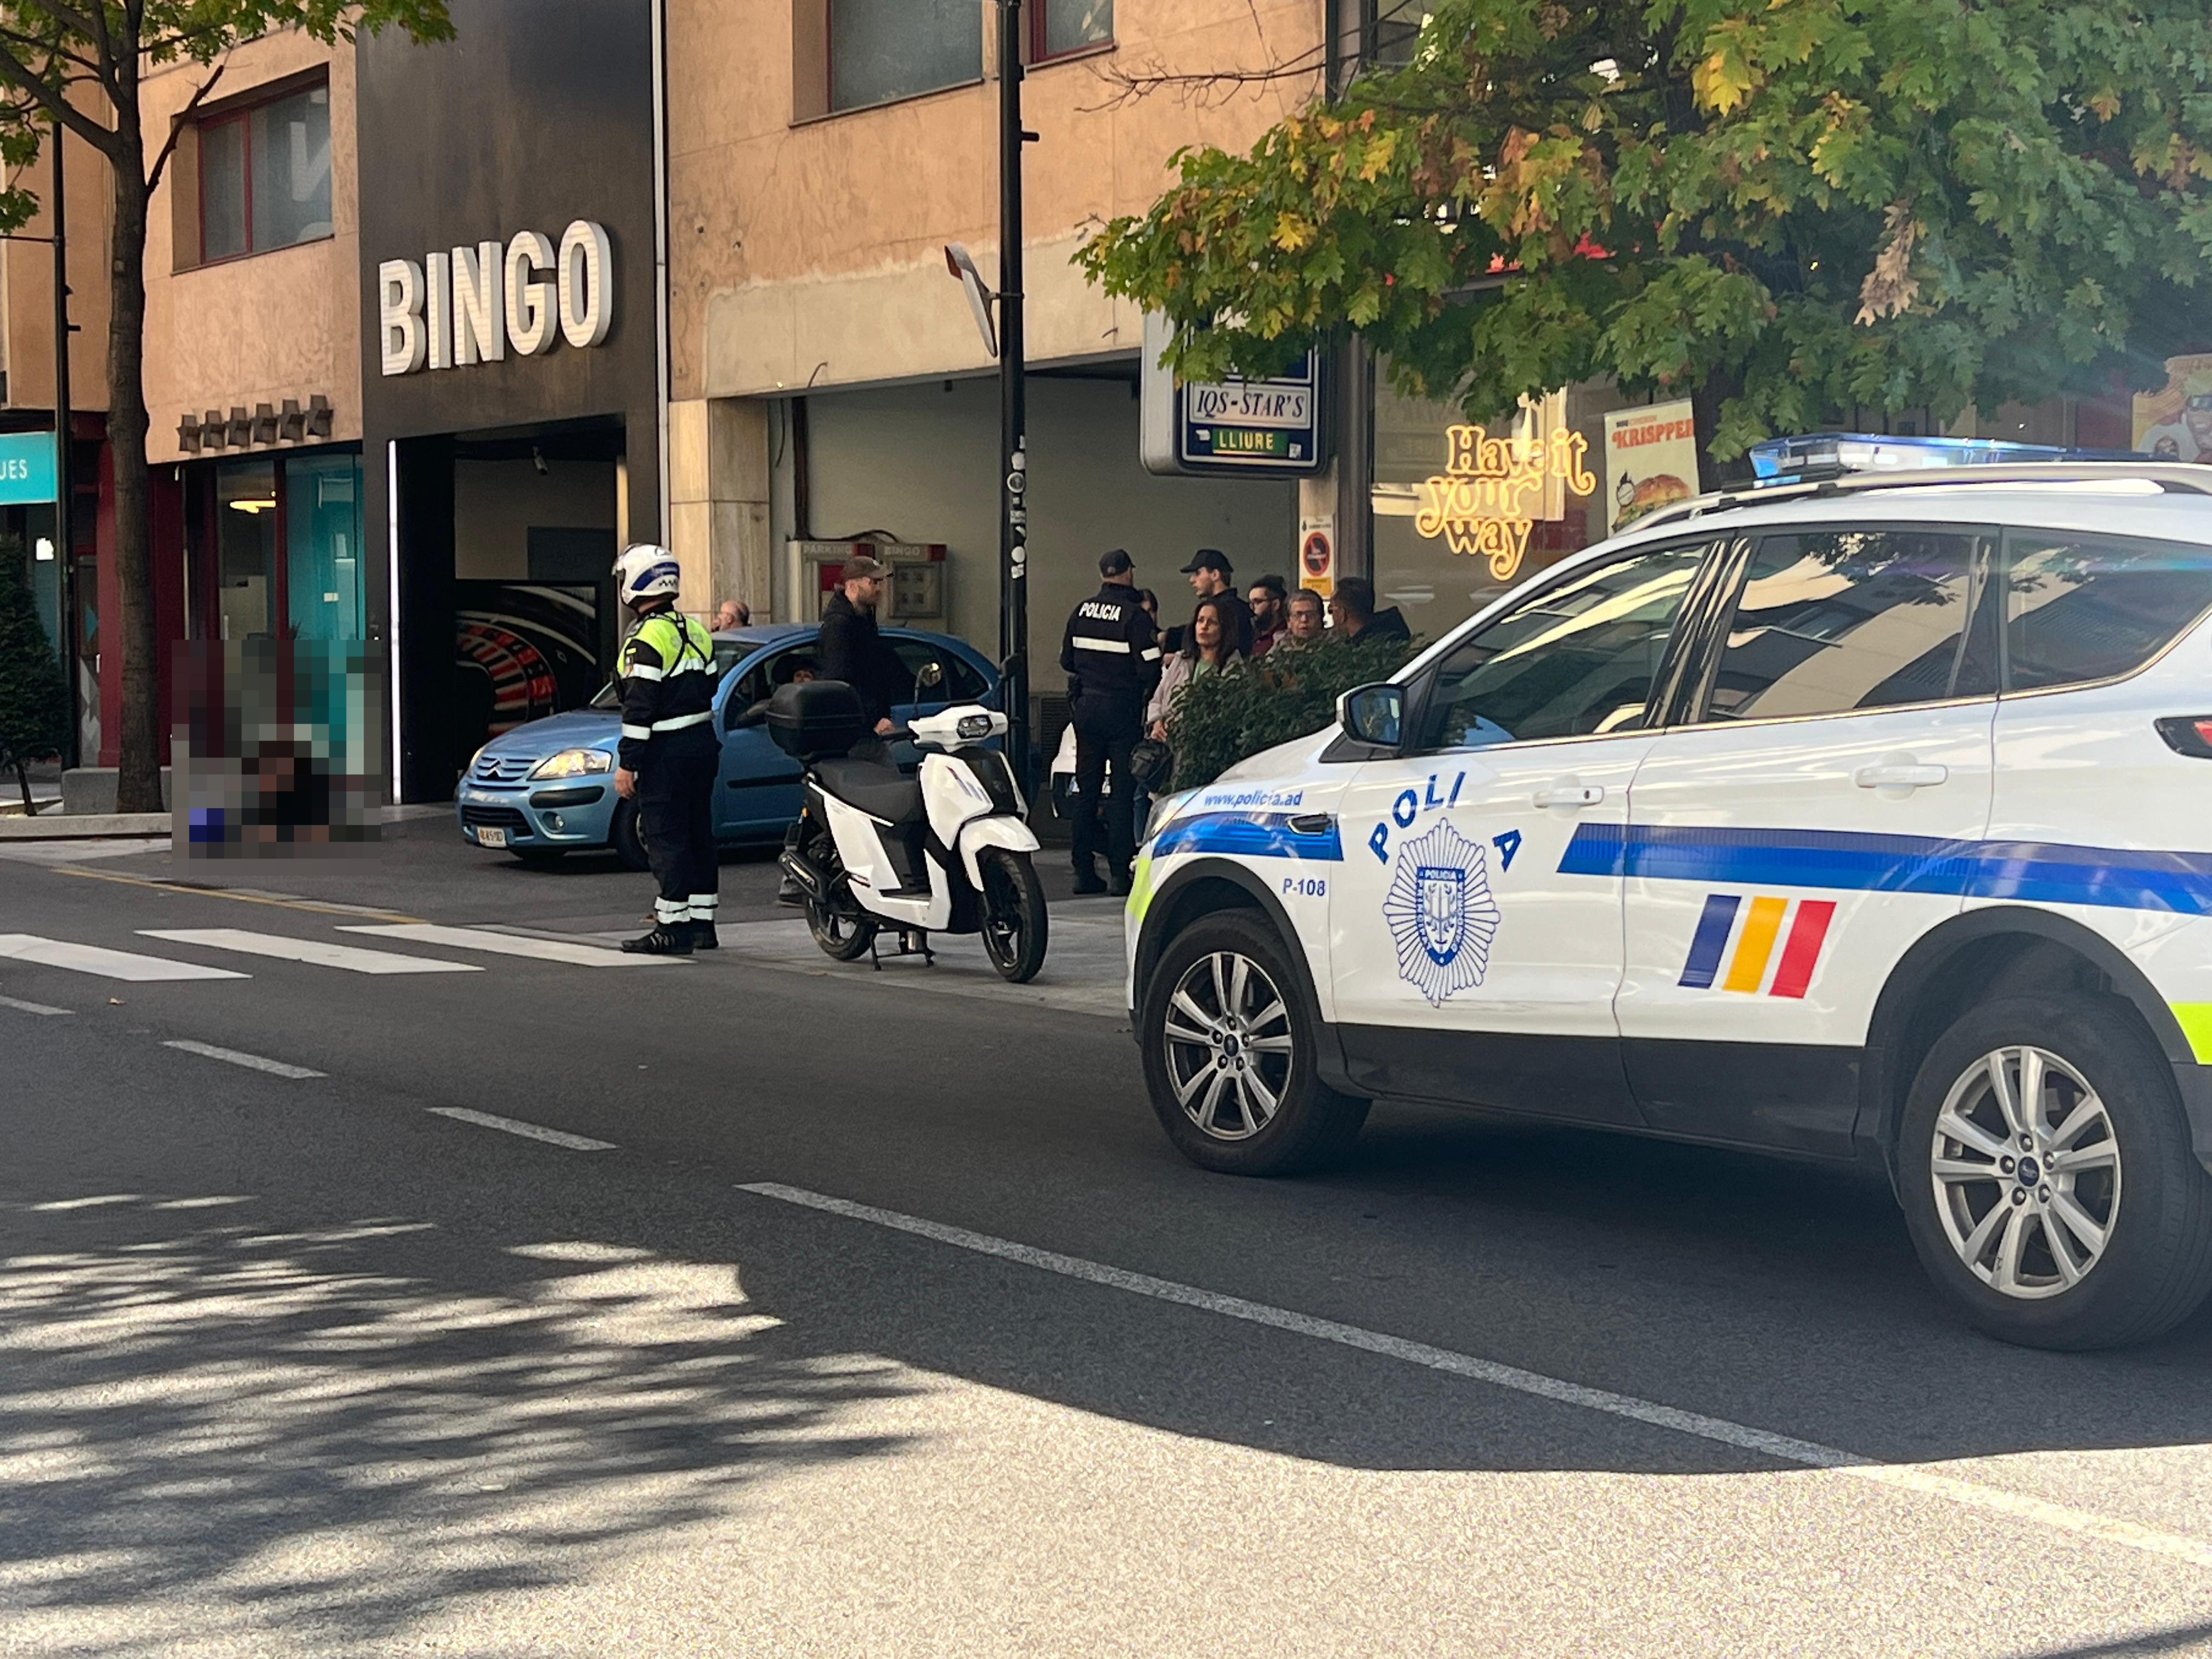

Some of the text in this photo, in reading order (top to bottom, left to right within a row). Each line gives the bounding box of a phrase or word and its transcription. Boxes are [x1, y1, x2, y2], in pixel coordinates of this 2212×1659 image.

[379, 219, 612, 376] BINGO
[1219, 430, 1274, 450] LLIURE
[1445, 424, 1597, 496] Have it
[1415, 475, 1543, 539] your
[803, 545, 853, 554] PARKING
[1443, 517, 1533, 582] way
[1078, 602, 1122, 622] POLICIA
[1204, 790, 1304, 809] www.policia.ad
[1282, 878, 1325, 896] P-108
